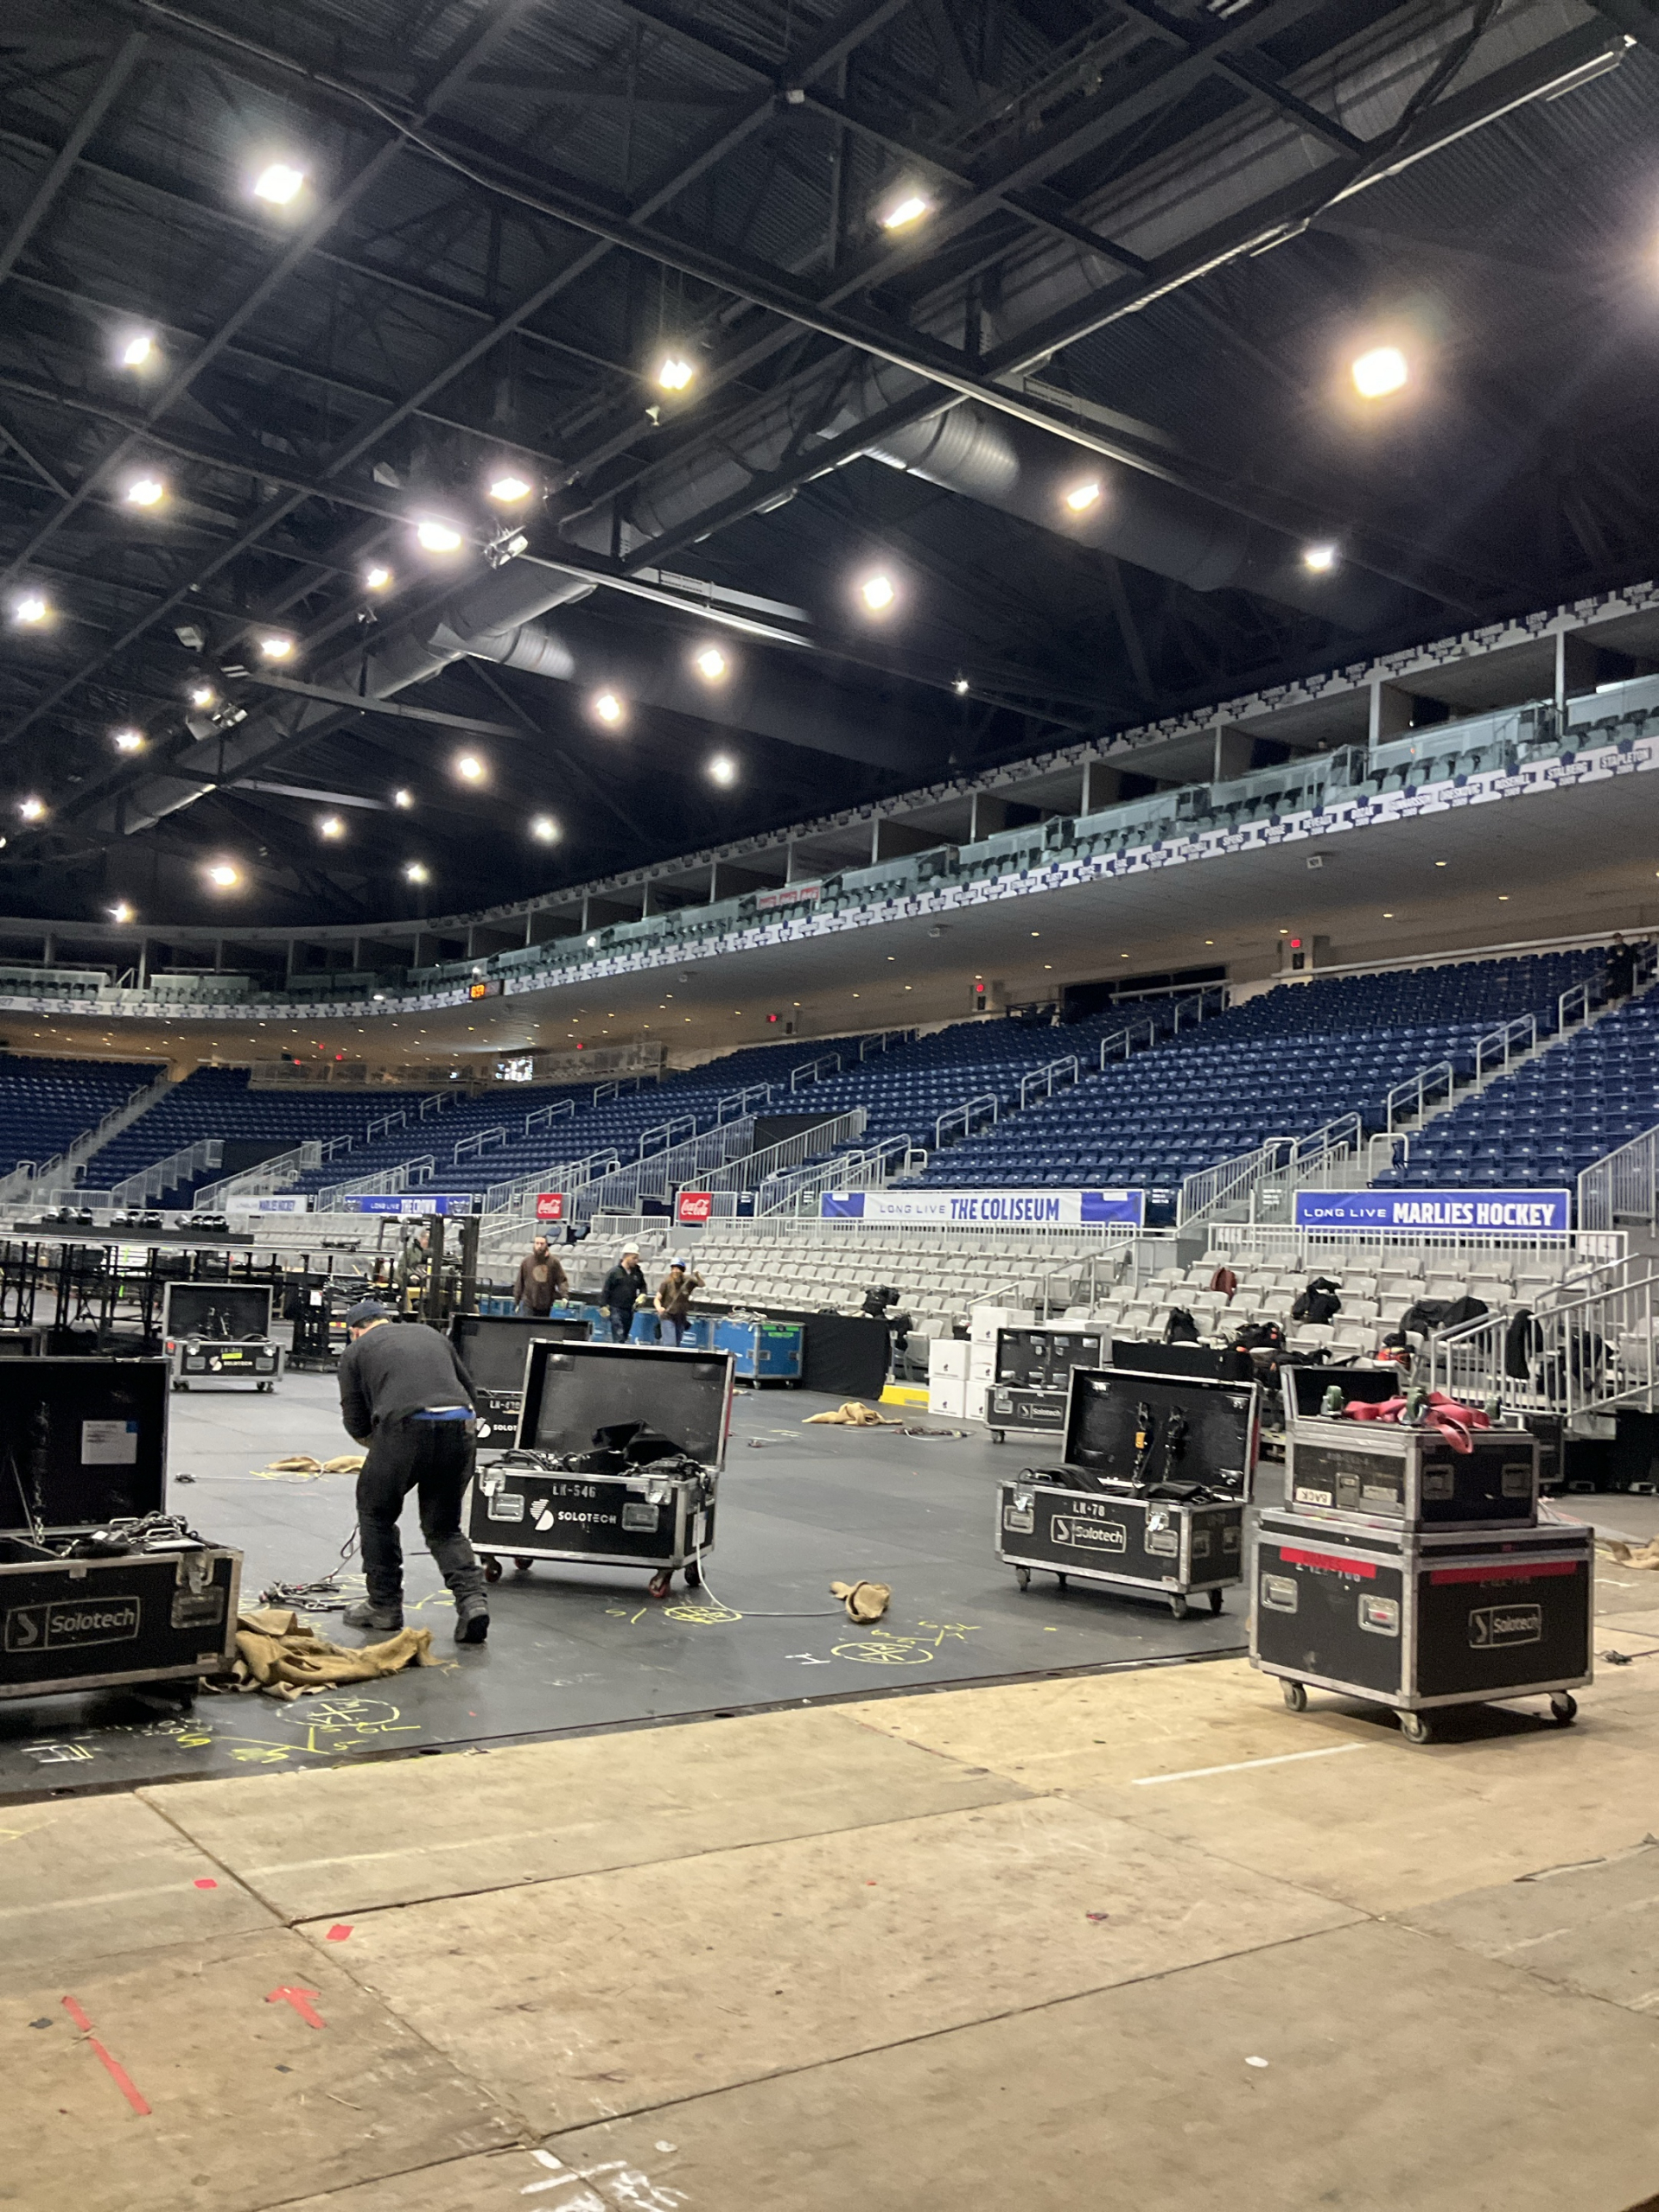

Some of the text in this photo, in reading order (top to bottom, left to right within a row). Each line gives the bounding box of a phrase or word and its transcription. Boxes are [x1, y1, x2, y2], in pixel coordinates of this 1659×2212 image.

[1601, 748, 1649, 768] STAPLETON
[1548, 761, 1588, 779] STALBERG
[537, 1199, 561, 1214] Coca-Cola
[680, 1198, 710, 1216] Coca-Cola
[880, 1198, 1059, 1221] LONG LIVE THE COLISEUM
[1304, 1203, 1556, 1226] LONG LIVE MARLIES HOCKEY
[1033, 1408, 1062, 1417] Solotech
[1301, 1491, 1328, 1503] BACK
[558, 1511, 617, 1524] SOLOTECH
[1075, 1526, 1123, 1543] Solotech
[50, 1607, 136, 1633] Solotech
